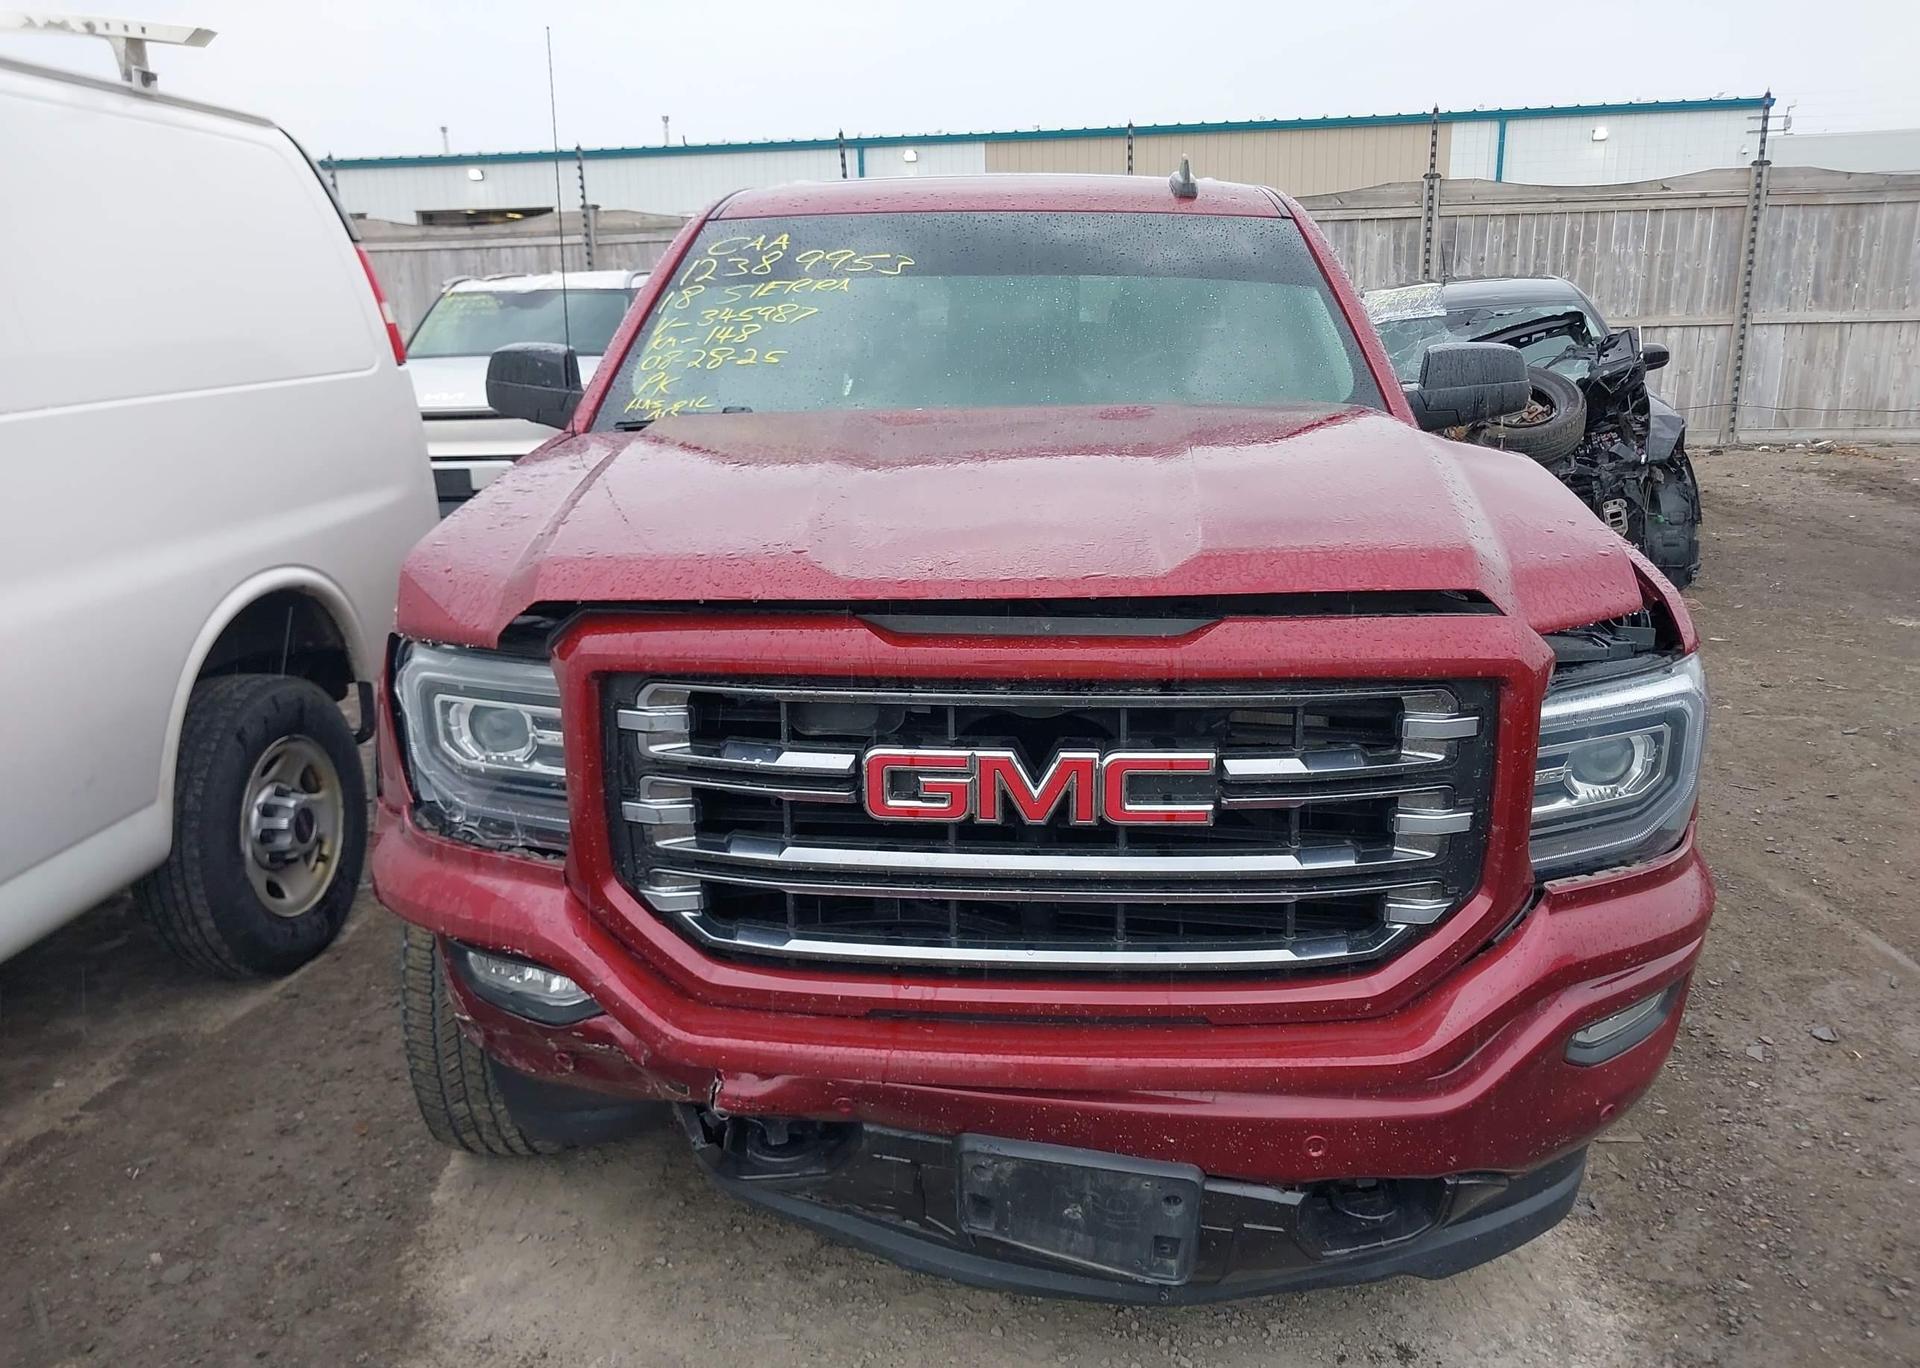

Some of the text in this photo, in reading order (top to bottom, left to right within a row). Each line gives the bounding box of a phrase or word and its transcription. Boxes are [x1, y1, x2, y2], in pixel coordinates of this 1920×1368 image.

[708, 233, 790, 256] CAA
[715, 277, 850, 305] SIERRA
[863, 746, 1216, 827] GMC
